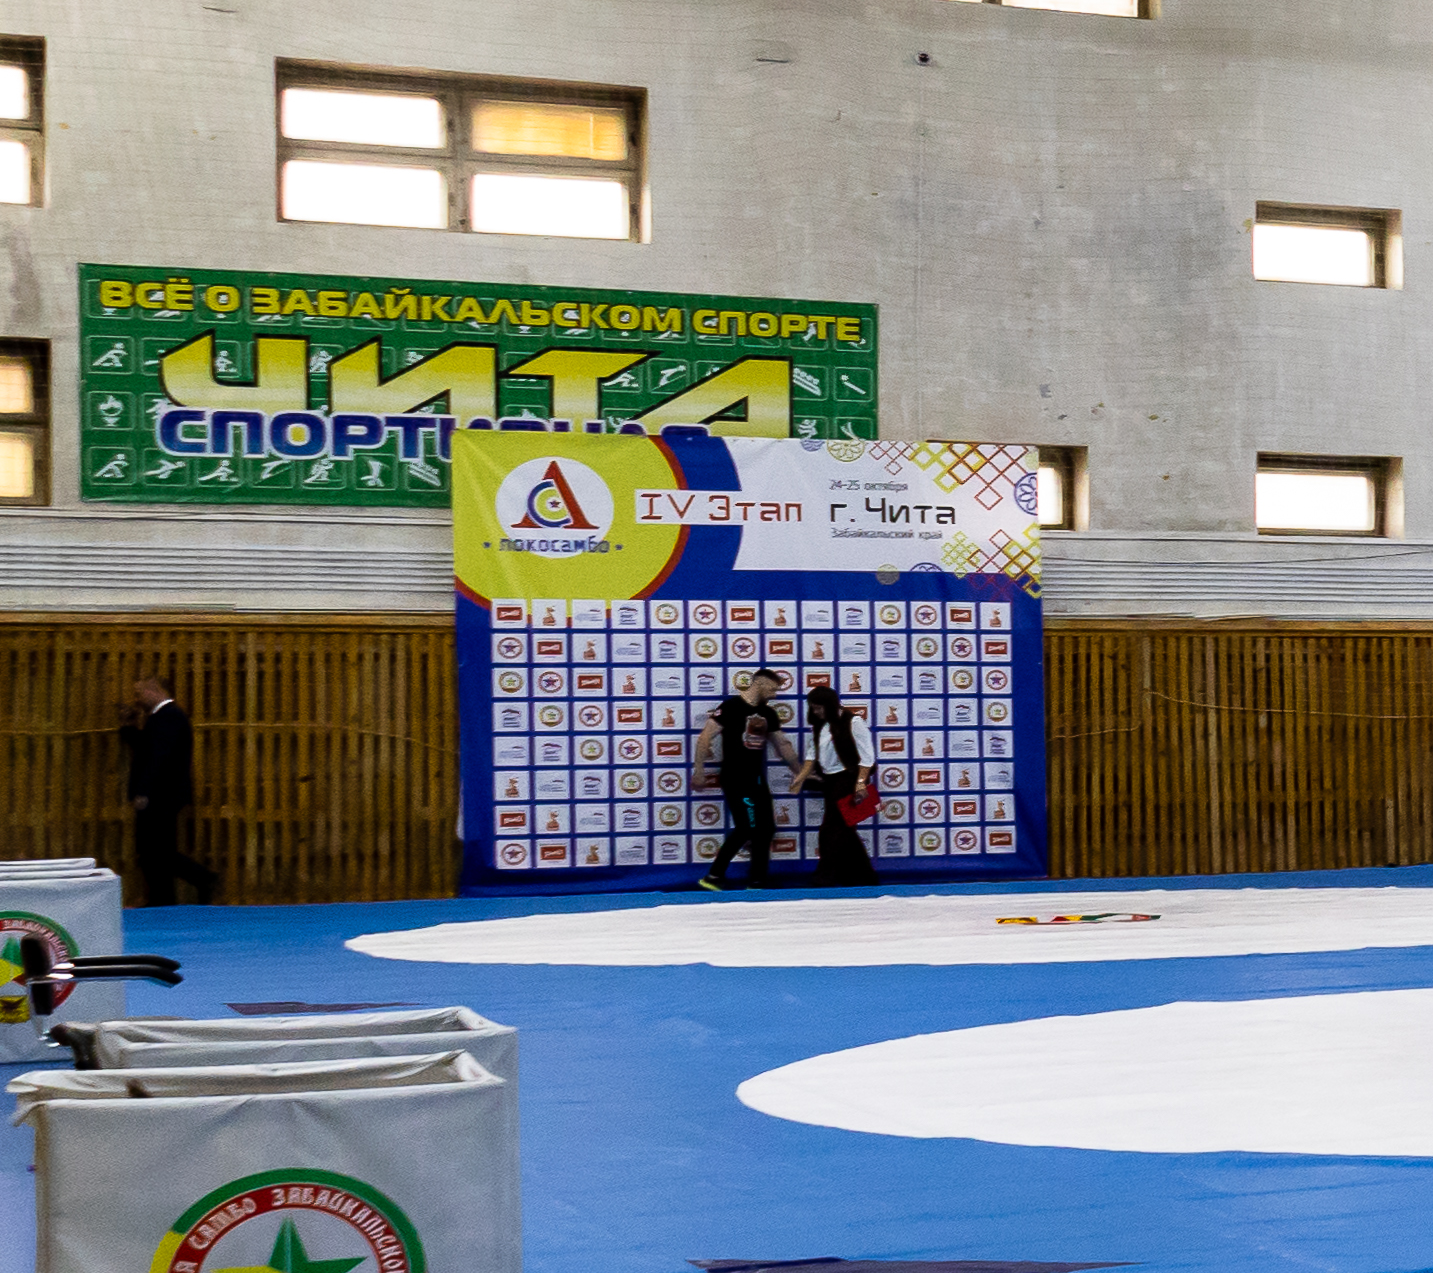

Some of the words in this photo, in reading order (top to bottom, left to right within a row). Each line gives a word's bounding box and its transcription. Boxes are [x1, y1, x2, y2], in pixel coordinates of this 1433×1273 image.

[99, 278, 194, 311] ВСЁ
[203, 284, 241, 313] О
[251, 287, 682, 333] ЗАБАЙКАЛЬСКОМ
[692, 309, 862, 343] СПОРТЕ
[159, 328, 794, 438] ЧИТА
[641, 493, 695, 521] IV
[708, 493, 802, 522] Этап
[830, 503, 856, 523] г.
[865, 497, 956, 525] Чита
[499, 535, 610, 554] локосамбо
